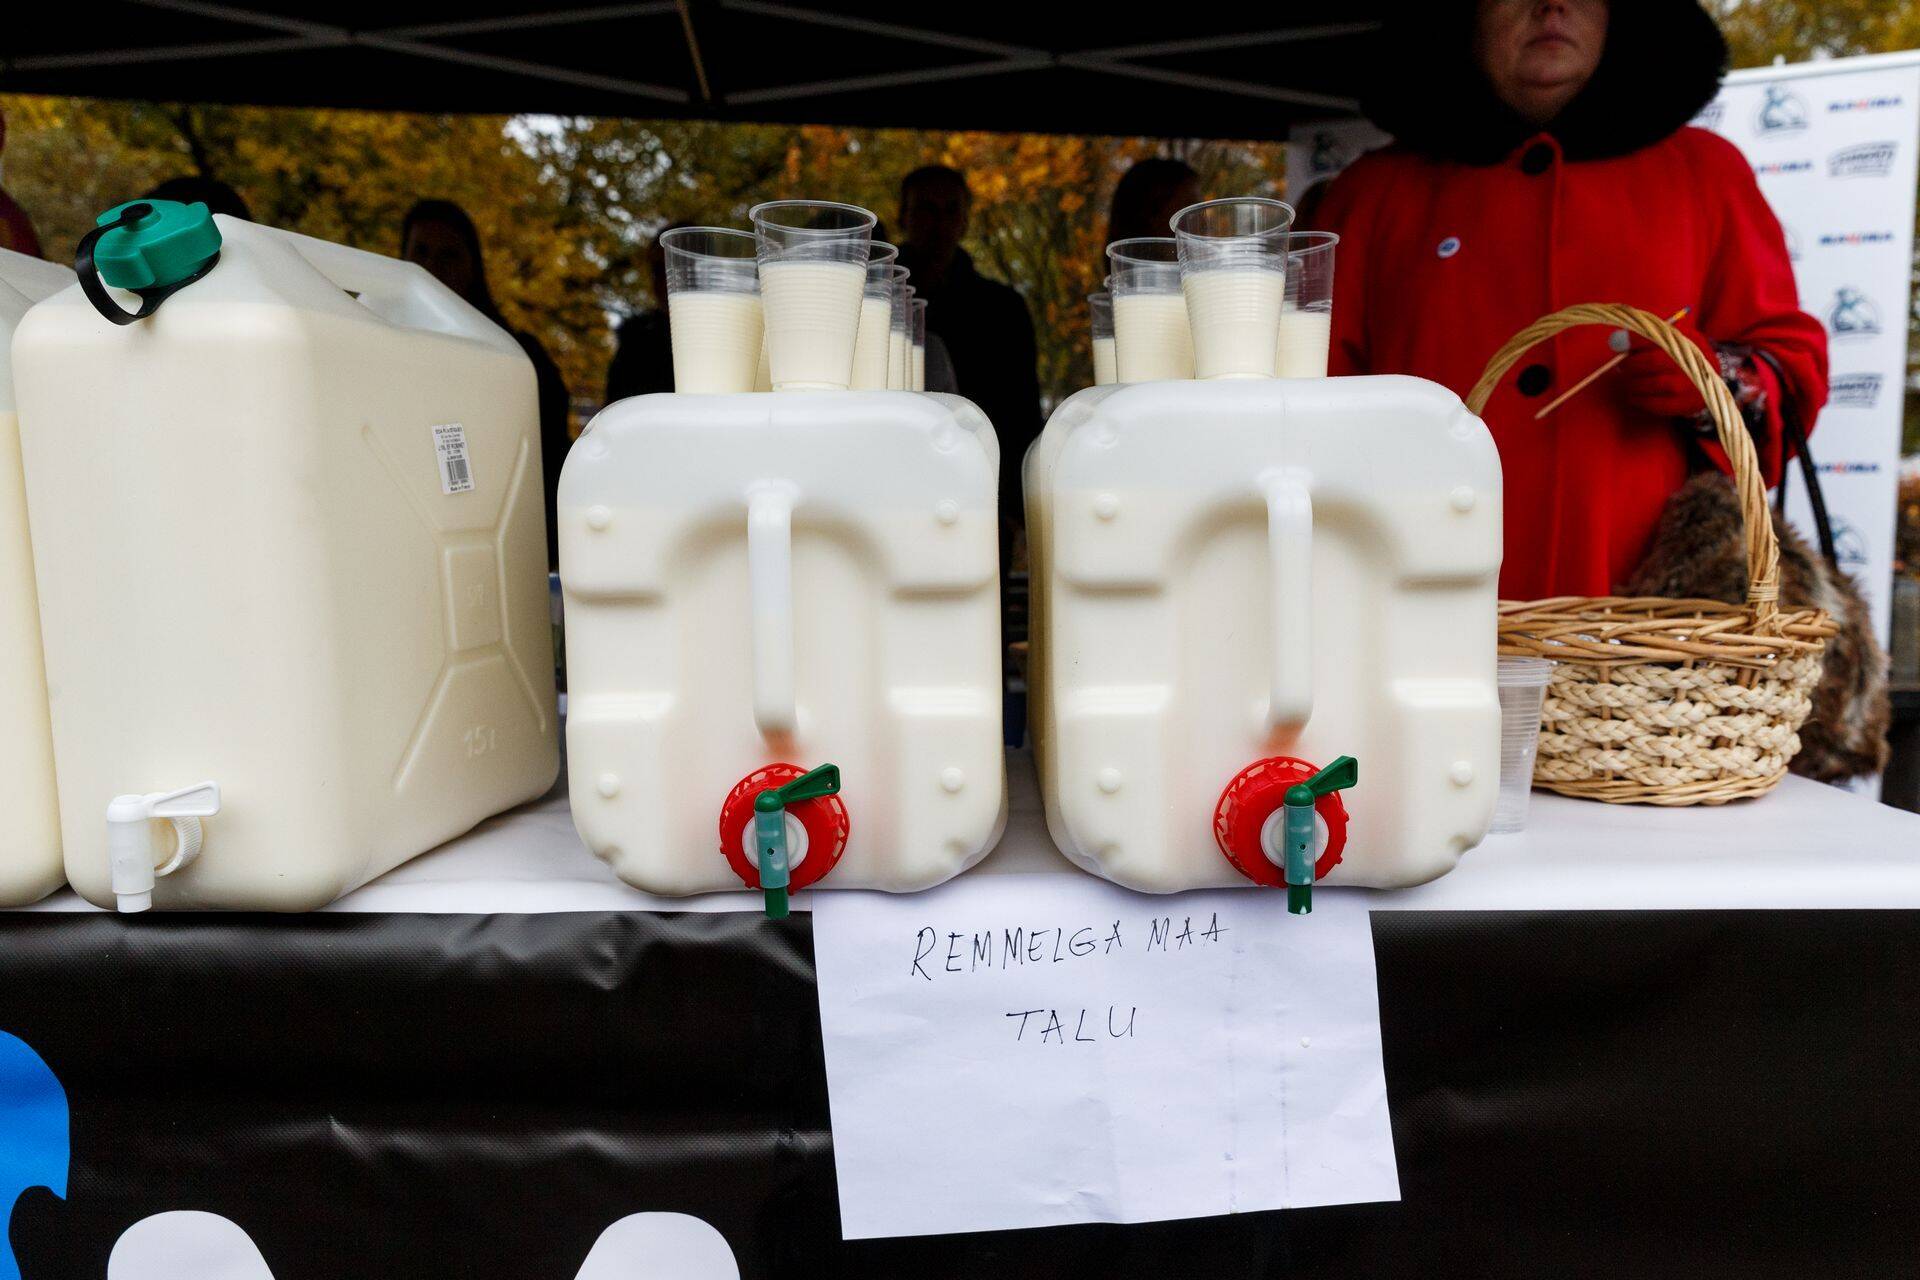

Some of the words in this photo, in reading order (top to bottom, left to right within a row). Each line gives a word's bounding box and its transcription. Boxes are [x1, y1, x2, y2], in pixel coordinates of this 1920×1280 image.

[911, 919, 1123, 981] REMMELGA
[1147, 912, 1229, 953] MAA
[1005, 1005, 1137, 1045] TALU
